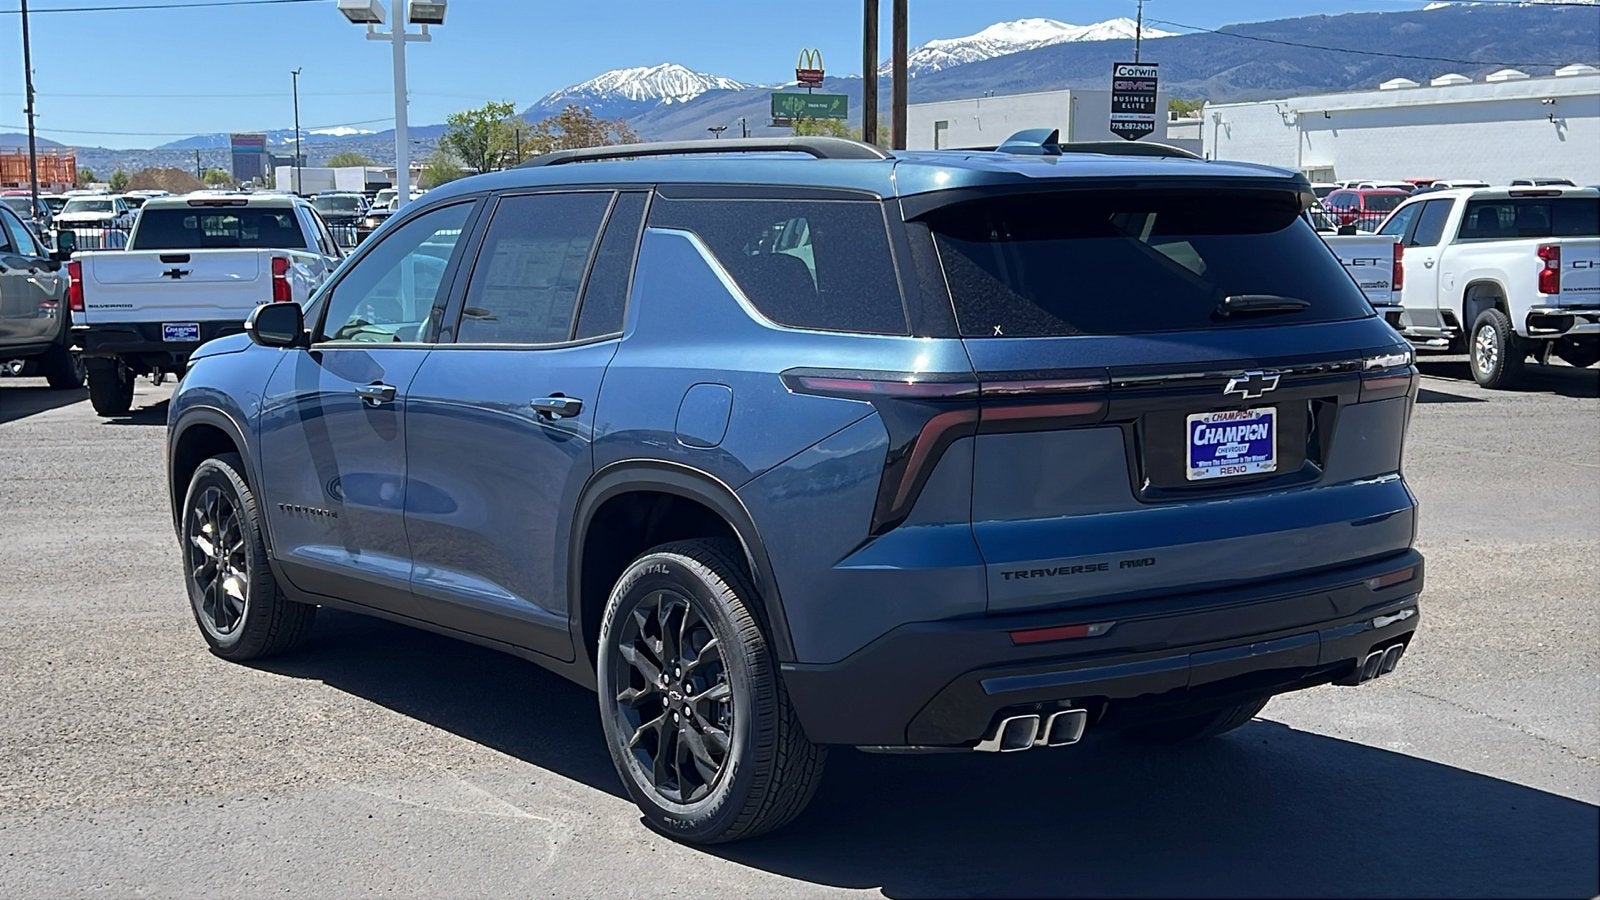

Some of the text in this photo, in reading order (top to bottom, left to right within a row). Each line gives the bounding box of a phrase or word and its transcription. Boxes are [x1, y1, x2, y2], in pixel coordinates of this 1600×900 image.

[1118, 66, 1157, 77] Corwin
[1114, 81, 1155, 90] GMC
[1212, 410, 1253, 423] CHAMPION
[1193, 423, 1269, 446] CHAMPION
[1217, 445, 1247, 454] CHEVROLET
[1220, 465, 1247, 475] RENO
[1001, 557, 1156, 580] TRAVERSE AWD
